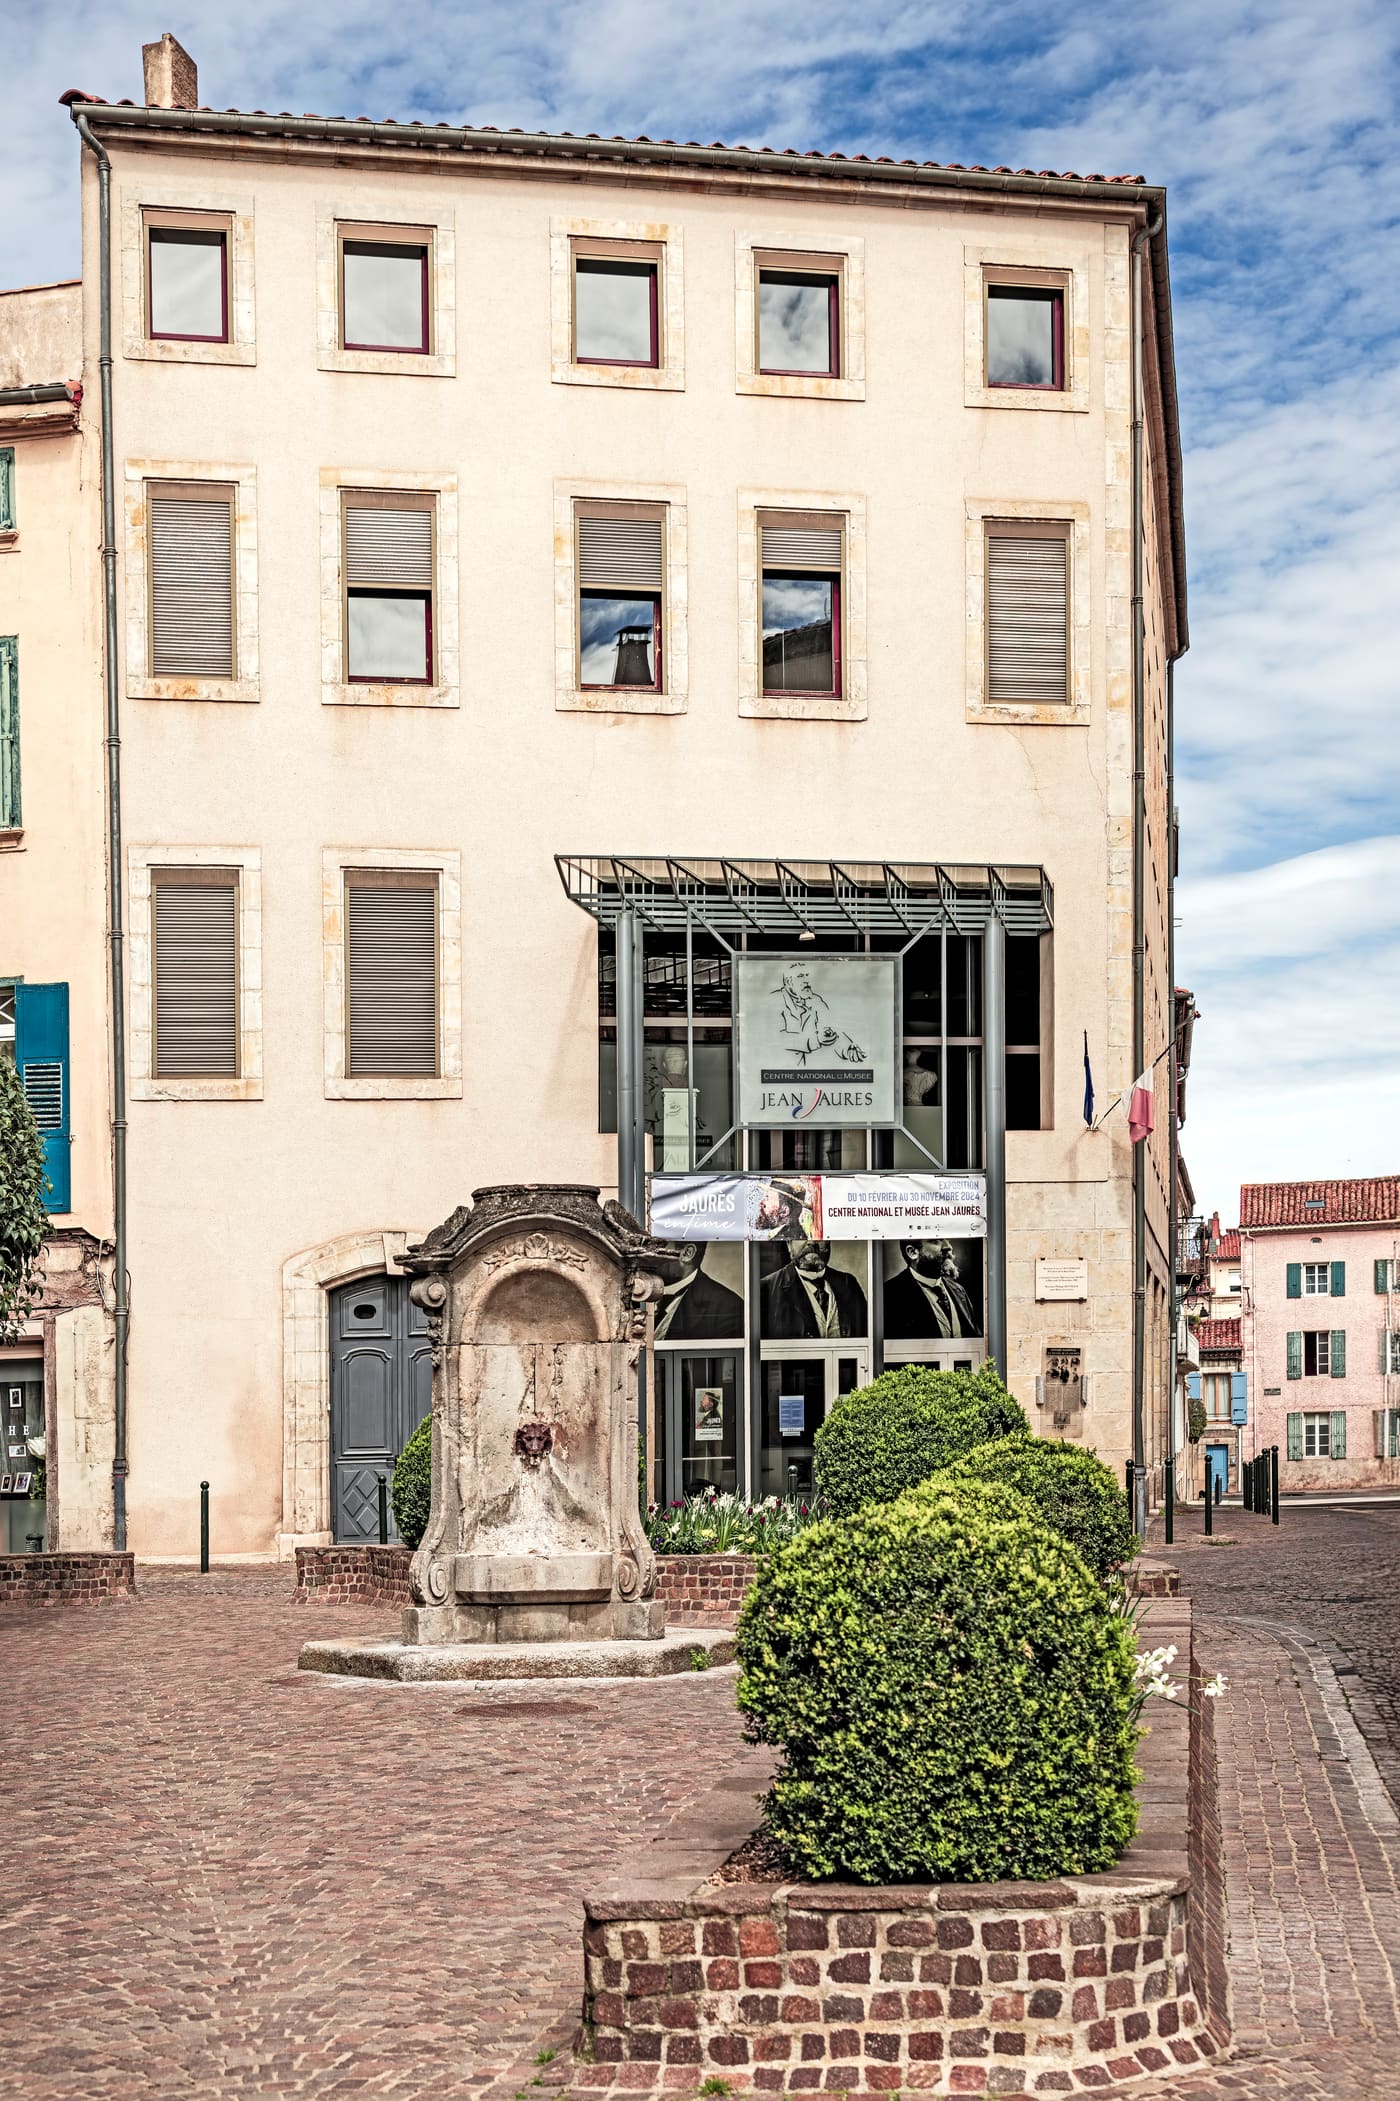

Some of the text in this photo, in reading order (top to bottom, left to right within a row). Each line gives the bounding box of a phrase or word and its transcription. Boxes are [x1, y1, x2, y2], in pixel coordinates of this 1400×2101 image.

[763, 1072, 795, 1080] CENTRE
[797, 1072, 836, 1080] NATIONAL
[760, 1087, 873, 1119] JEAN JAURES
[938, 1181, 980, 1191] EXPOSITION
[679, 1190, 735, 1212] JAURÈS
[847, 1191, 980, 1202] DU 10 FÉVRIER AU 30 NOVEMBRE 2024
[828, 1204, 981, 1217] CENTRE NATIONAL ET MUSÉE JEAN JAURÈS
